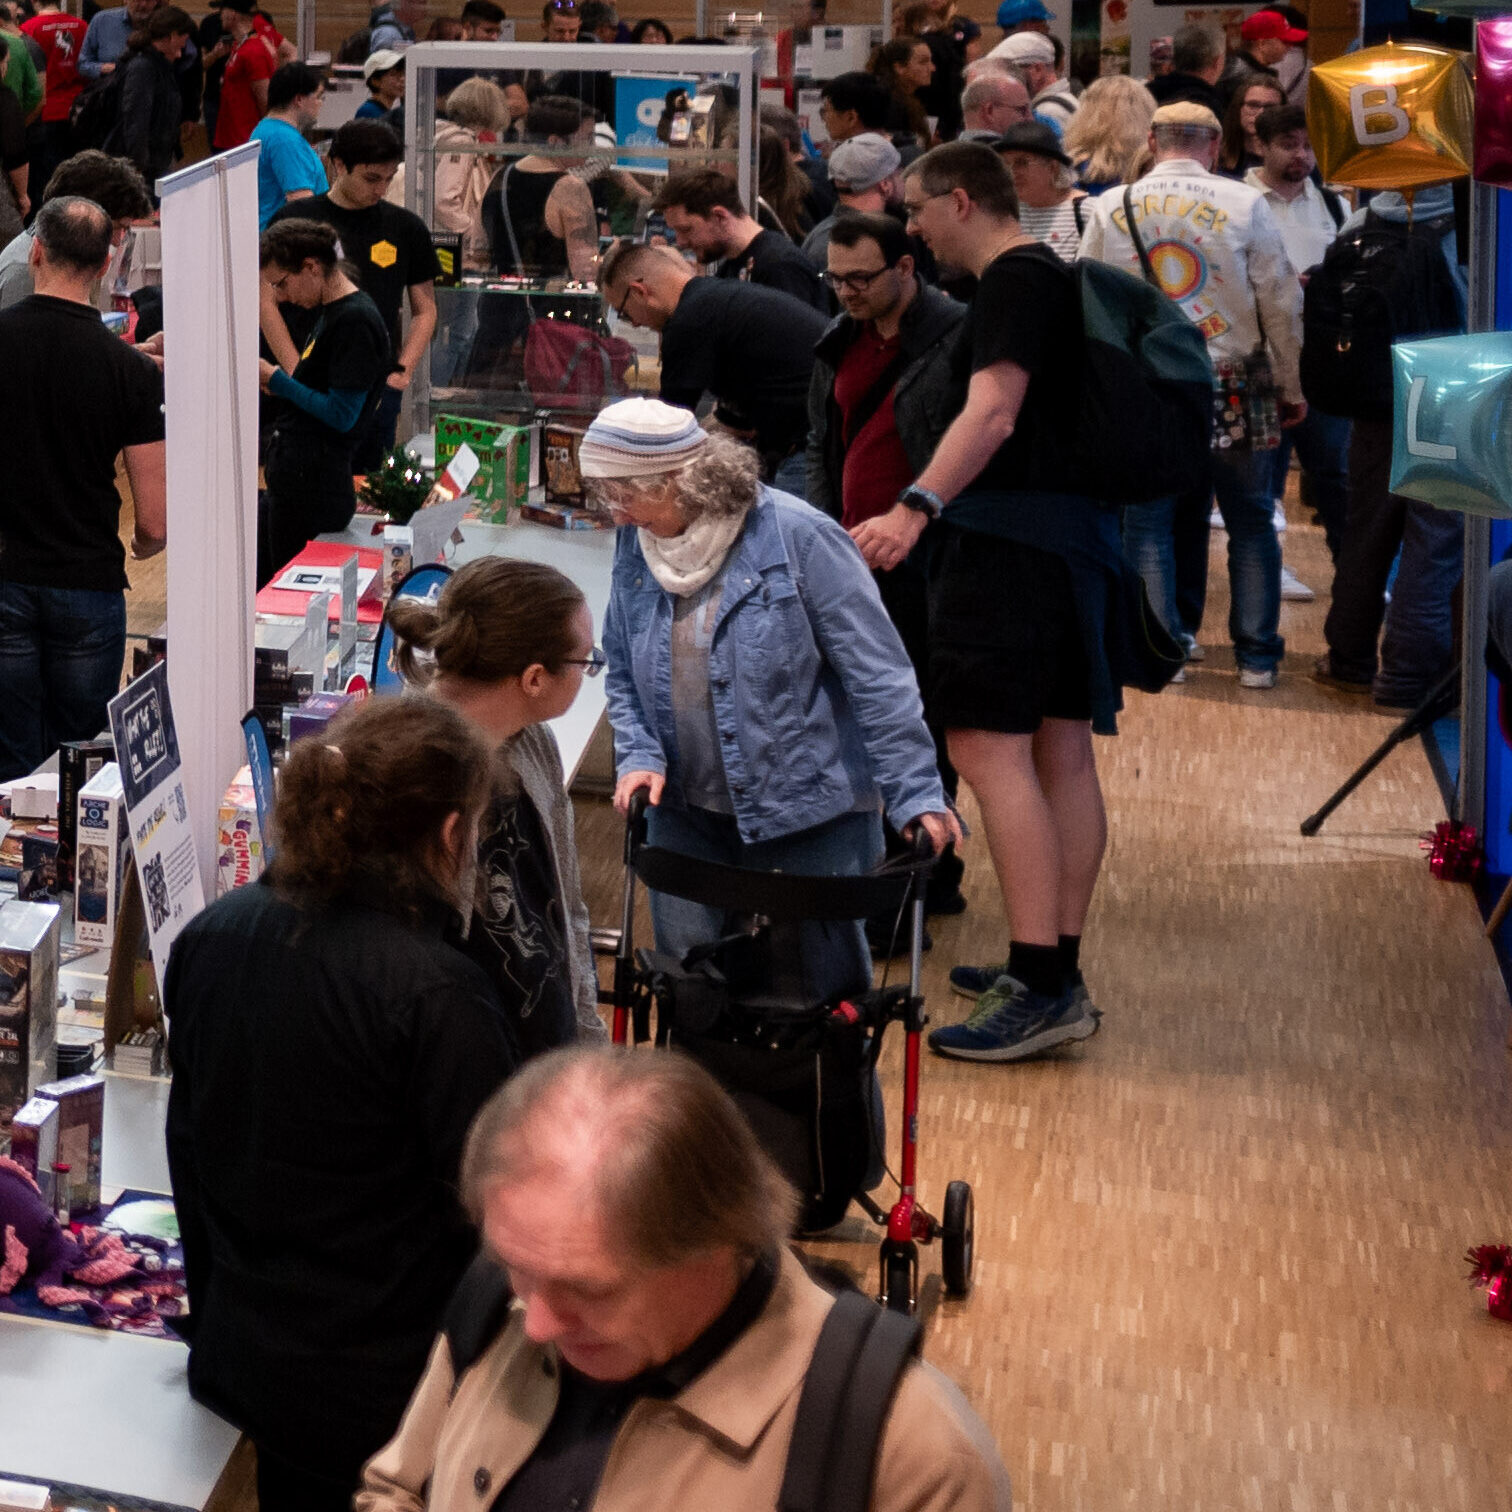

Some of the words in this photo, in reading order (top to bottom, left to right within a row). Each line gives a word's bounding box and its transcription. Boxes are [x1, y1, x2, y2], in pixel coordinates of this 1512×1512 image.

[1349, 82, 1410, 147] B
[1111, 194, 1230, 236] FOREVER
[1406, 376, 1456, 459] L
[79, 817, 110, 830] LOGIC
